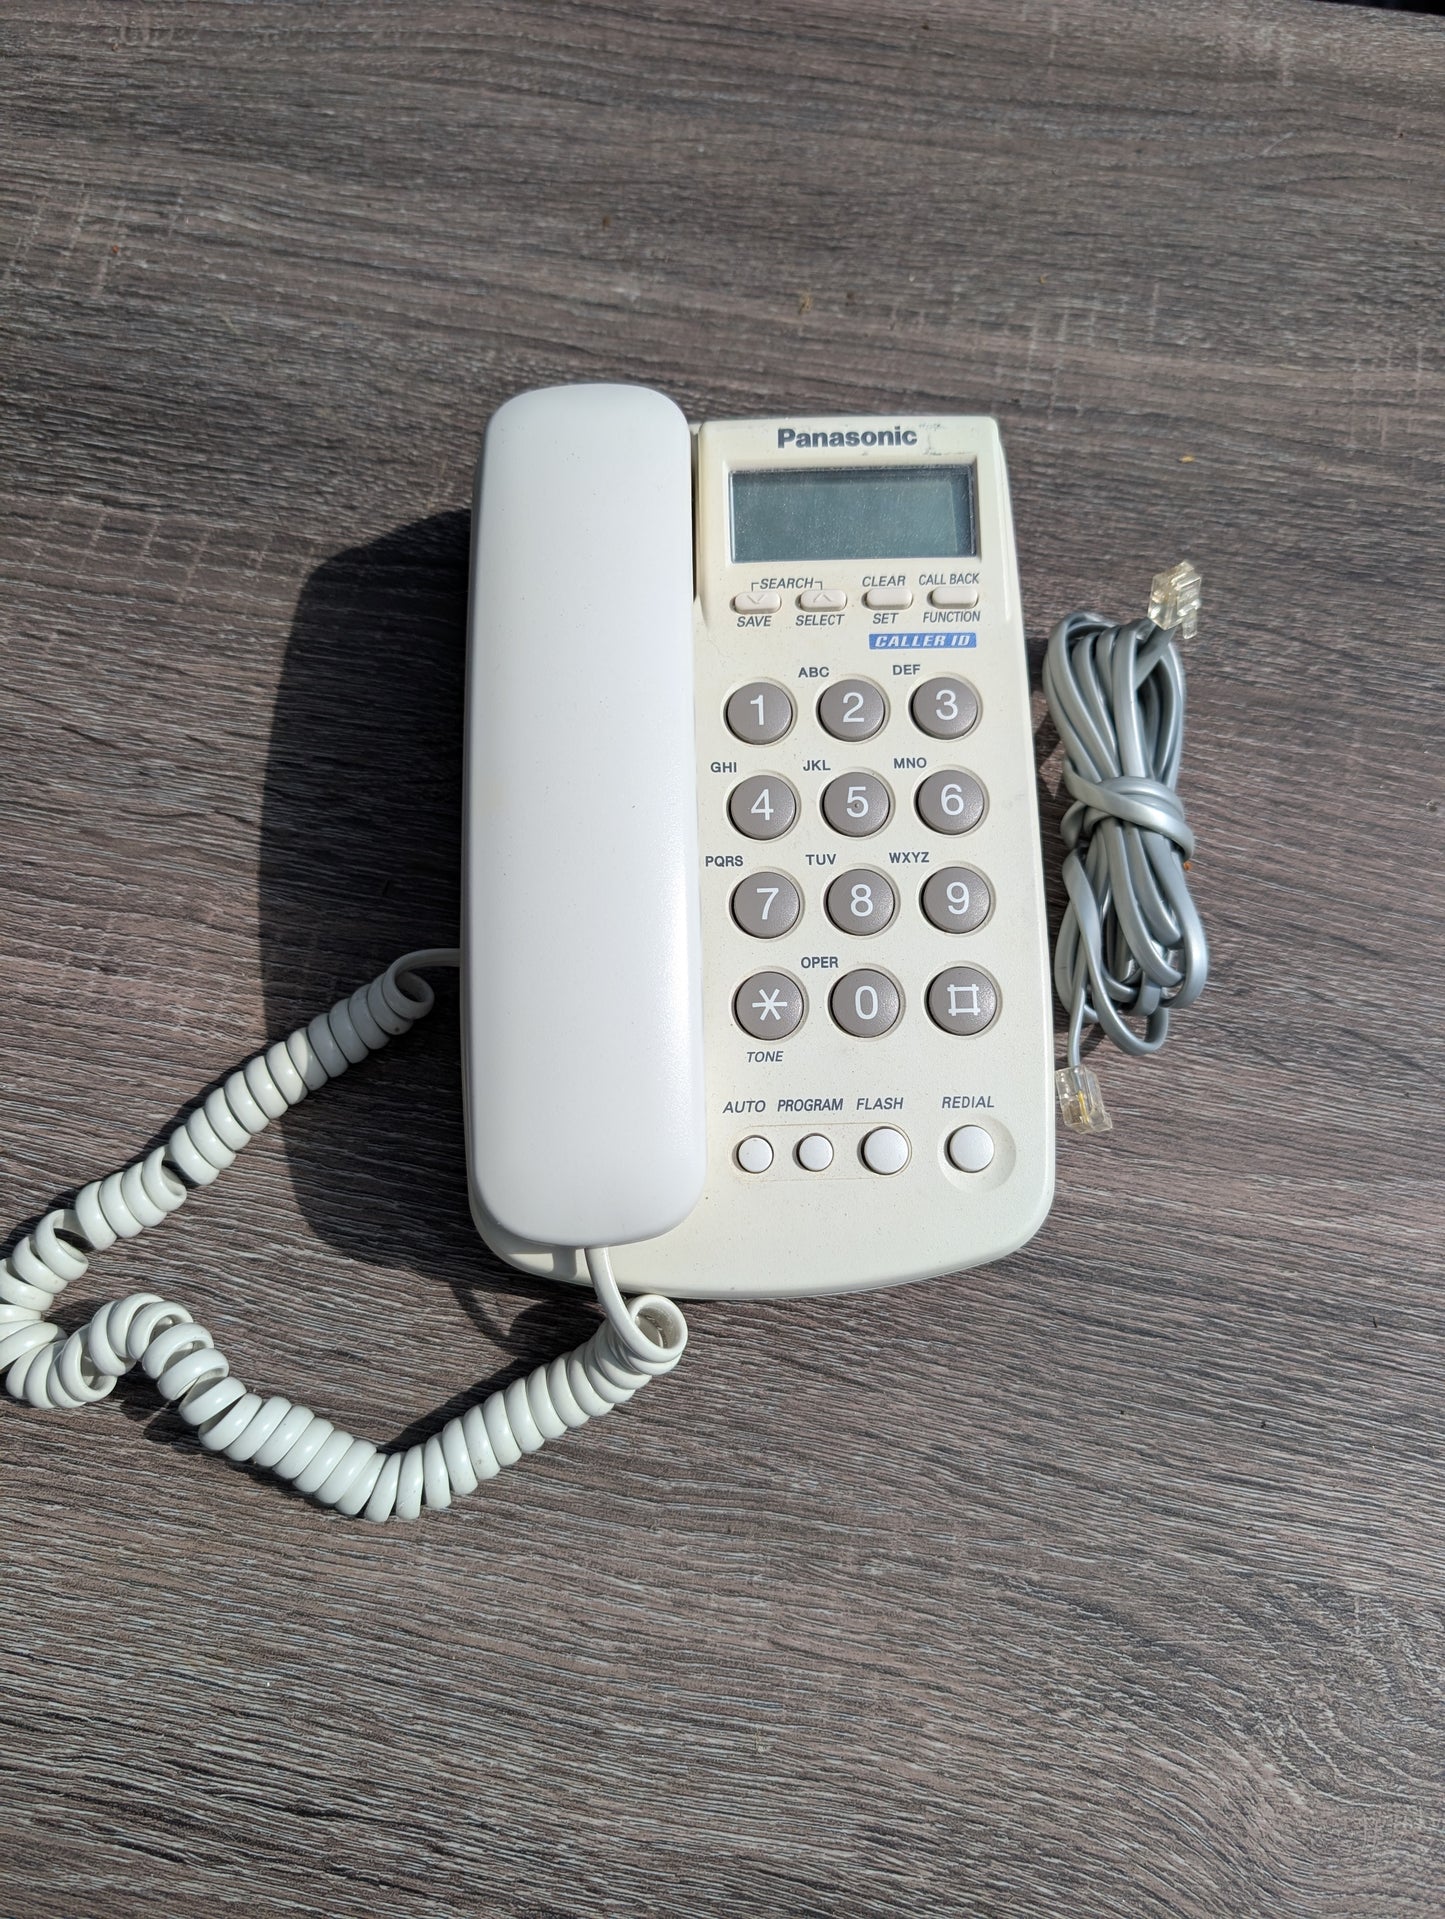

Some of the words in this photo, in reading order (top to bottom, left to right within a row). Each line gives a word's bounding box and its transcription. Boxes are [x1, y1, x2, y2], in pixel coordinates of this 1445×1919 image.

[777, 426, 918, 449] Panasonic
[759, 577, 814, 590] SEARCH
[862, 575, 906, 587] CLEAR
[918, 573, 947, 586] CALL
[949, 572, 980, 585] BACK
[736, 615, 772, 628] SAVE
[795, 613, 845, 626] SELECT
[872, 612, 899, 625] SET
[922, 611, 981, 623] FUNCTION
[874, 633, 946, 648] CALLER
[949, 633, 972, 647] ID
[798, 666, 830, 678] ABC
[892, 664, 921, 676] DEF
[750, 694, 765, 726] 1
[842, 692, 865, 723] 2
[935, 689, 959, 721] 3
[710, 761, 737, 773] GHI
[802, 759, 831, 772] JKL
[893, 757, 927, 769] MNO
[750, 788, 775, 821] 4
[846, 786, 869, 818] 5
[940, 783, 964, 816] 6
[705, 855, 744, 868] PQRS
[805, 854, 837, 866] TUV
[888, 852, 930, 864] WXYZ
[756, 887, 779, 920] 7
[850, 883, 874, 917] 8
[946, 881, 970, 915] 9
[800, 956, 839, 969] OPER
[854, 985, 878, 1020] 0
[746, 1050, 784, 1063] TONE
[722, 1100, 766, 1114] AUTO
[777, 1098, 844, 1112] PROGRAM
[856, 1097, 904, 1110] FLASH
[941, 1095, 995, 1109] REDIAL
